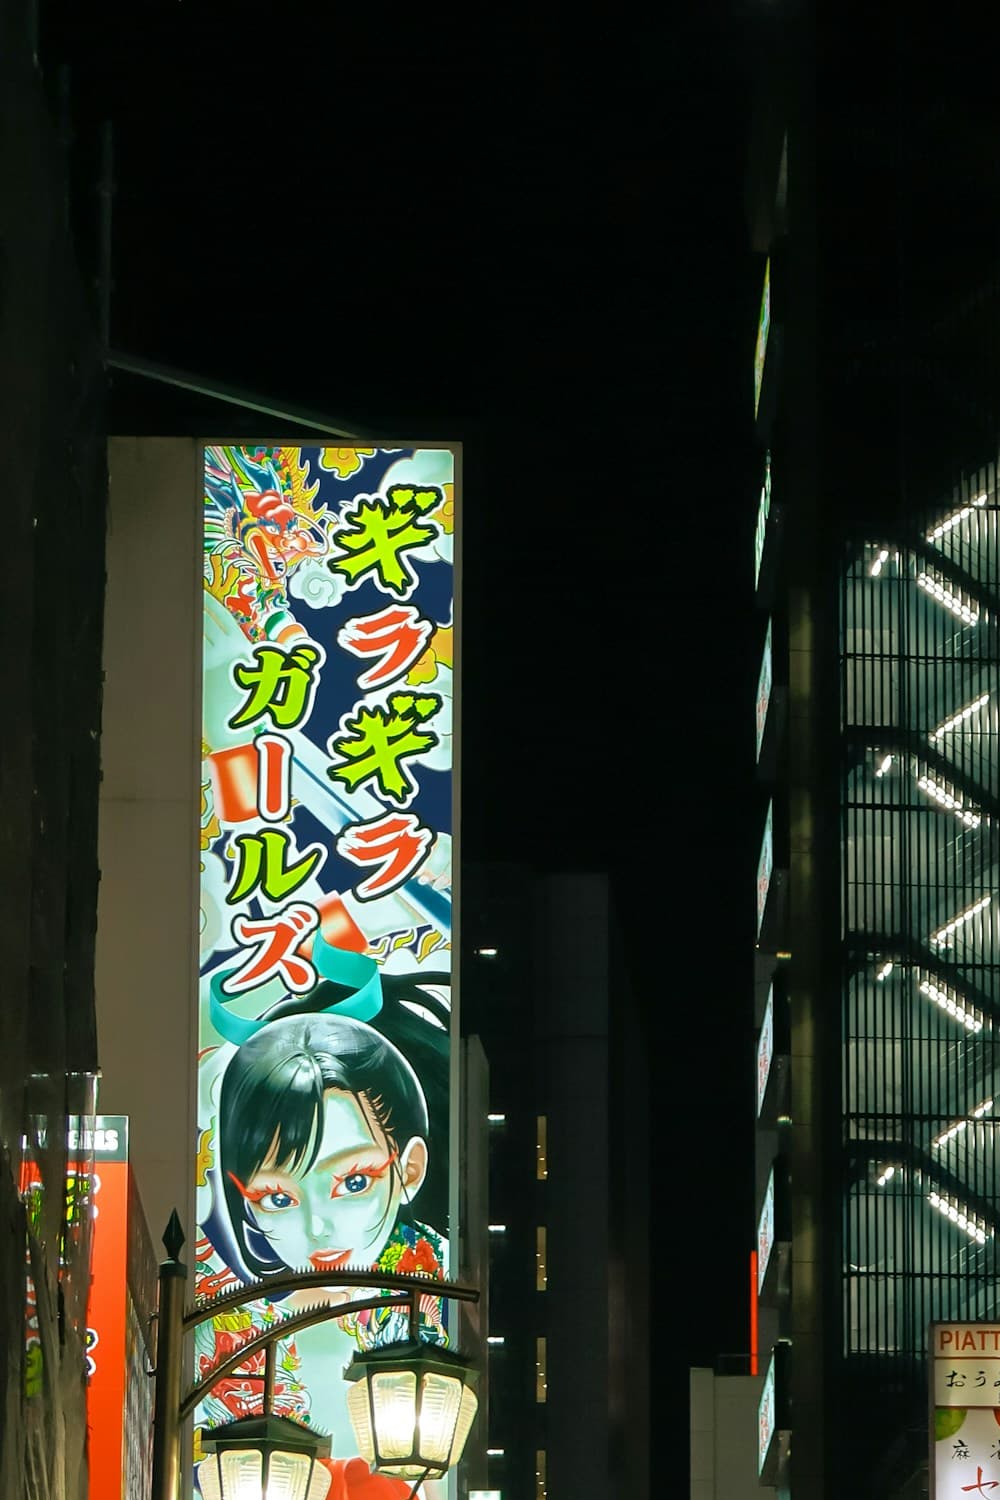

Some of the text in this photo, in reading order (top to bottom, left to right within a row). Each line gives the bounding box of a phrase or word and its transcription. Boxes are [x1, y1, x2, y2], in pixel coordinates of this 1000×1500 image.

[225, 642, 324, 995] ガールズ
[331, 483, 442, 903] ギラギラ
